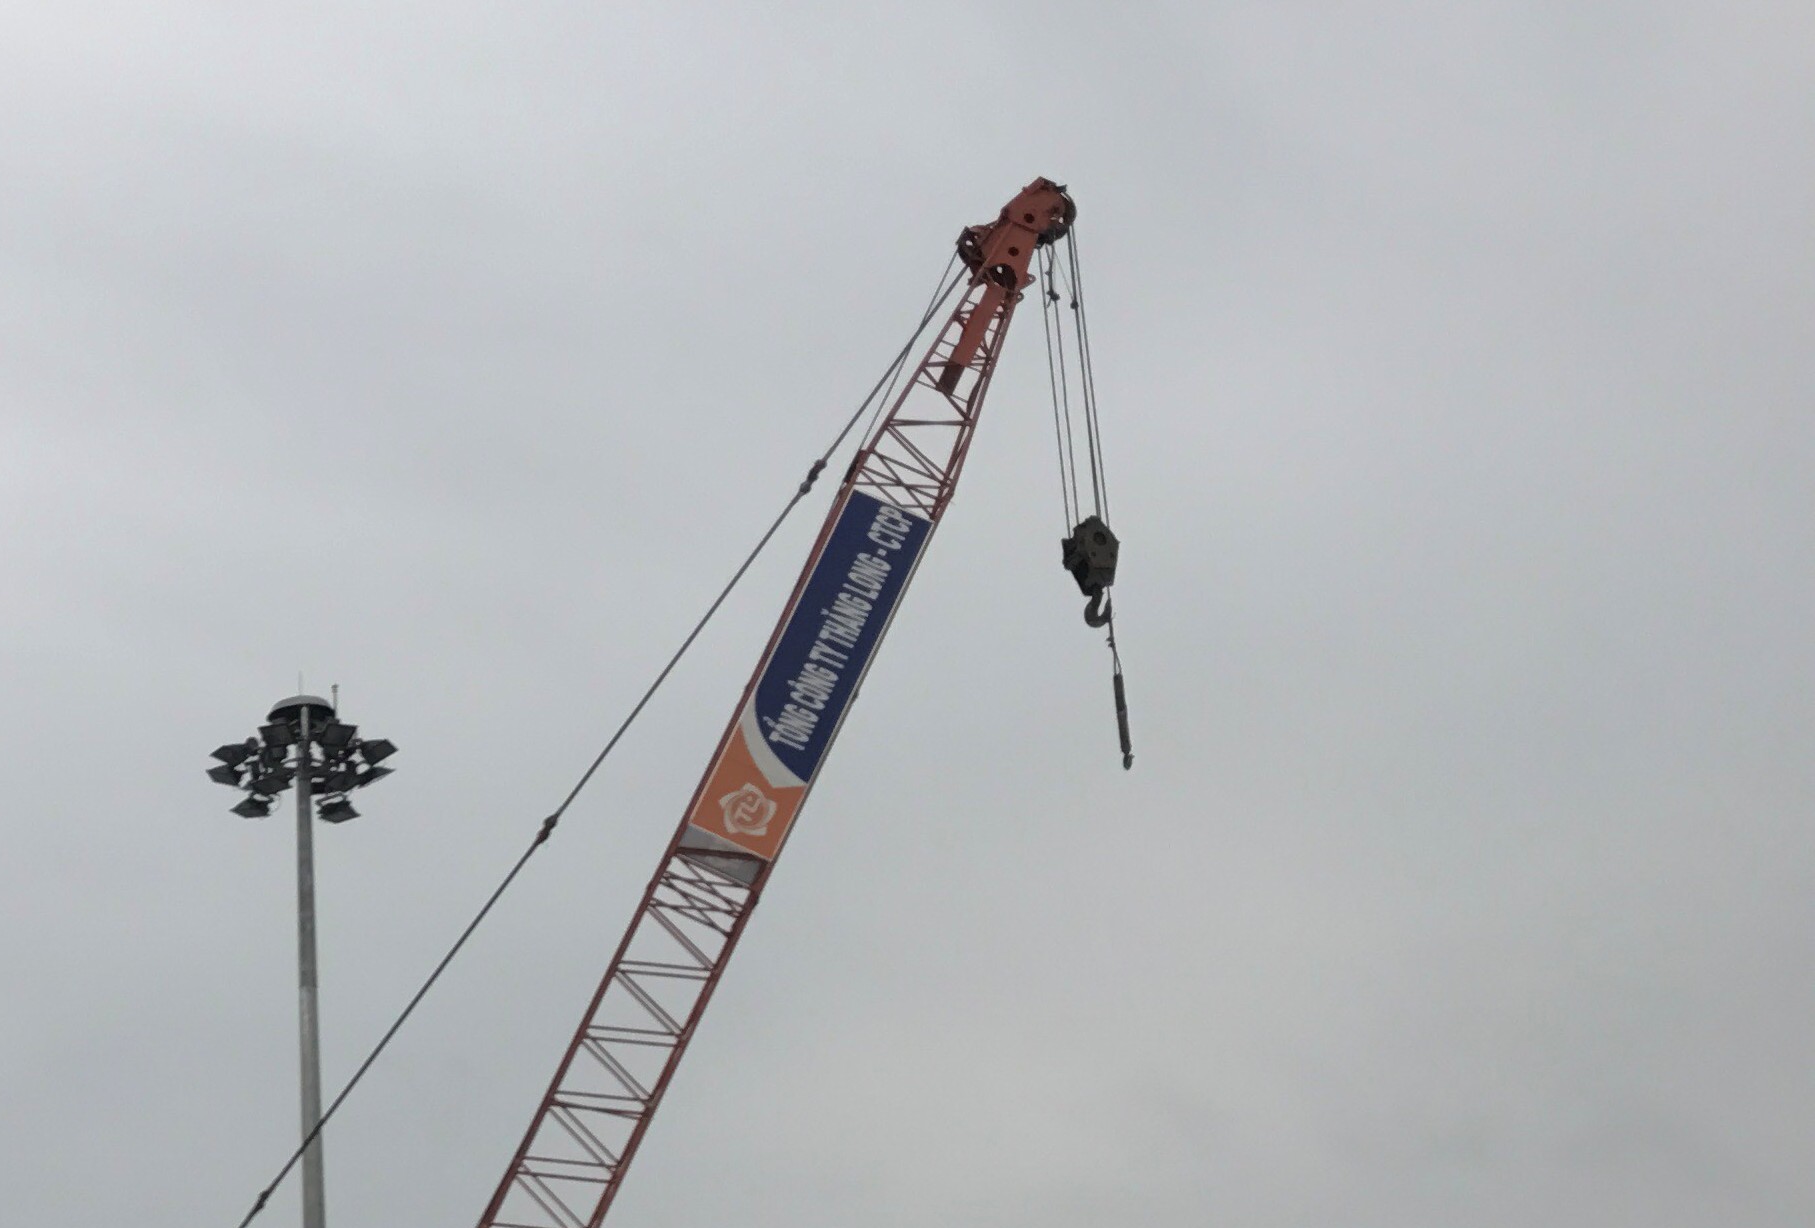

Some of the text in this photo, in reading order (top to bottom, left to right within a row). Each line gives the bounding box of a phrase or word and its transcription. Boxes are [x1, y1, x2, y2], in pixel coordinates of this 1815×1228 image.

[867, 505, 913, 550] CTCP
[842, 552, 892, 600] LONG
[819, 592, 873, 648] THĂNG
[809, 640, 849, 669] TY
[787, 662, 839, 710] CÔNG
[763, 703, 819, 750] TỔNG
